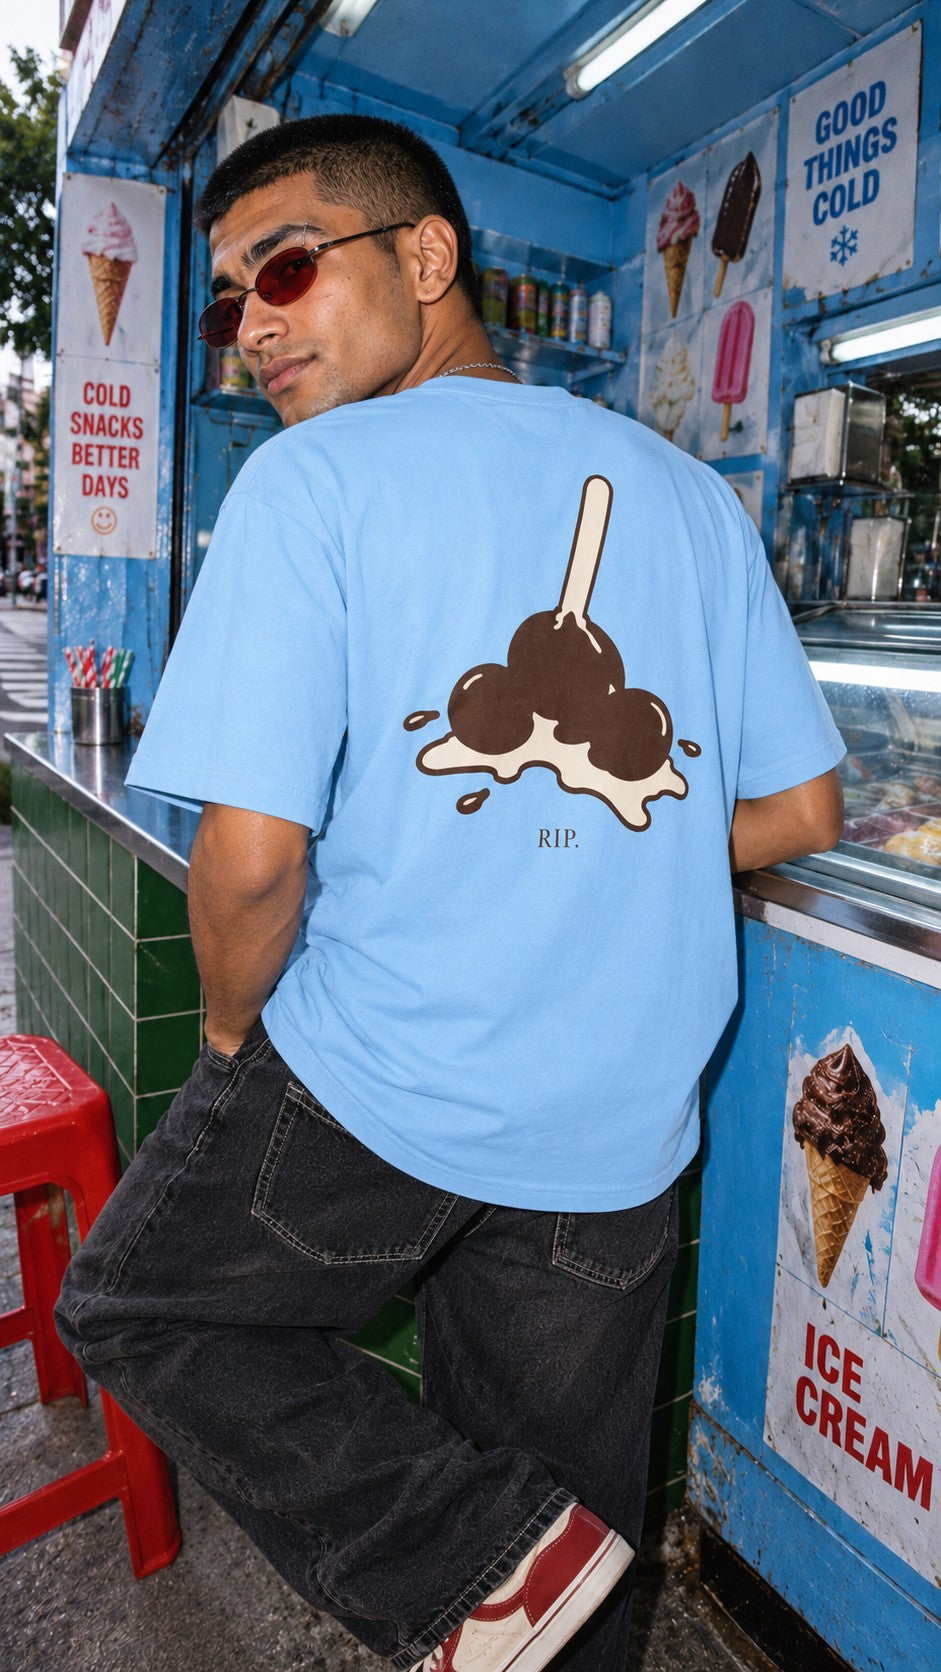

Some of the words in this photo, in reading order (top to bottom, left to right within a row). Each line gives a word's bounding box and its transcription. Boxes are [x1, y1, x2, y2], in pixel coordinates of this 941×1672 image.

[815, 80, 887, 145] GOOD
[804, 116, 897, 191] THINGS
[812, 168, 880, 226] COLD
[83, 381, 131, 408] COLD
[70, 411, 144, 440] SNACKS
[71, 442, 140, 470] BETTER
[82, 473, 129, 499] DAYS
[538, 828, 579, 848] RIP.
[804, 1323, 864, 1403] ICE
[795, 1376, 933, 1511] CREAM
